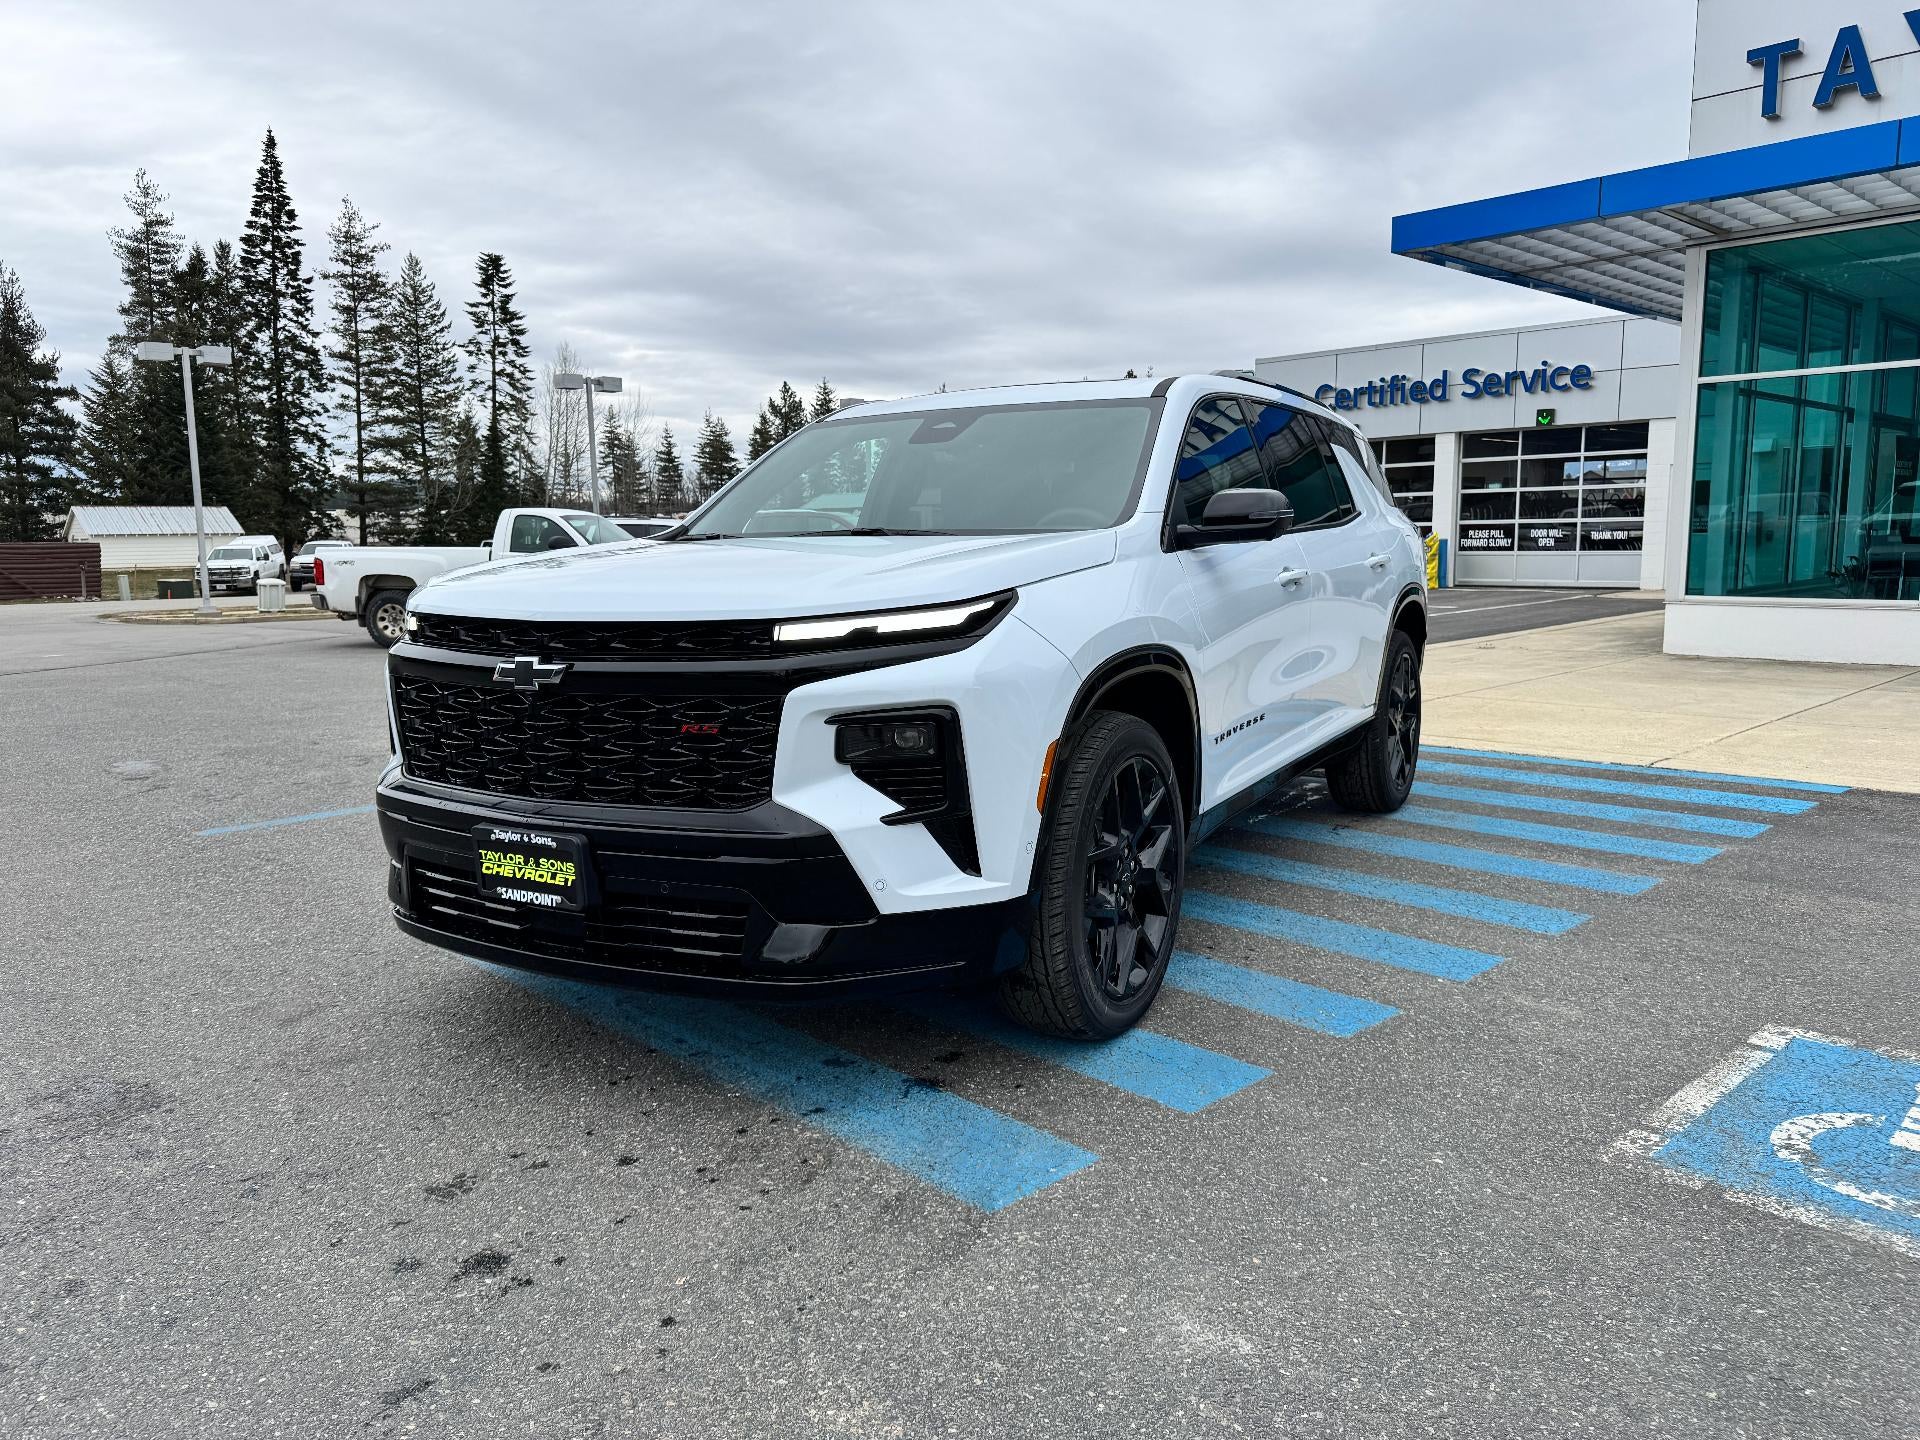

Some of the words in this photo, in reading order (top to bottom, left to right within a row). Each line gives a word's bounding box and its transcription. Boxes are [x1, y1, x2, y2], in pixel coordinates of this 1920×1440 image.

[1314, 370, 1449, 410] Certified
[1460, 360, 1592, 398] Service
[1468, 530, 1490, 538] PLEASE
[1490, 529, 1505, 538] PULL
[1530, 529, 1547, 538] DOOR
[1548, 529, 1564, 538] WILL
[1590, 531, 1611, 540] THANK
[1612, 531, 1628, 540] YOU!
[1460, 538, 1488, 547] FORWARD
[1488, 538, 1512, 547] SLOWLY
[1538, 538, 1555, 547] OPEN
[680, 723, 720, 735] RS
[1213, 712, 1266, 745] TRAVERSE
[493, 829, 521, 843] Taylor
[523, 833, 529, 842] &
[530, 833, 552, 846] Sons
[479, 849, 525, 866] TAYLOR
[527, 857, 536, 868] &
[539, 858, 575, 873] SONS
[481, 862, 576, 887] CHEVROLET
[501, 887, 558, 907] SANDPOINT
